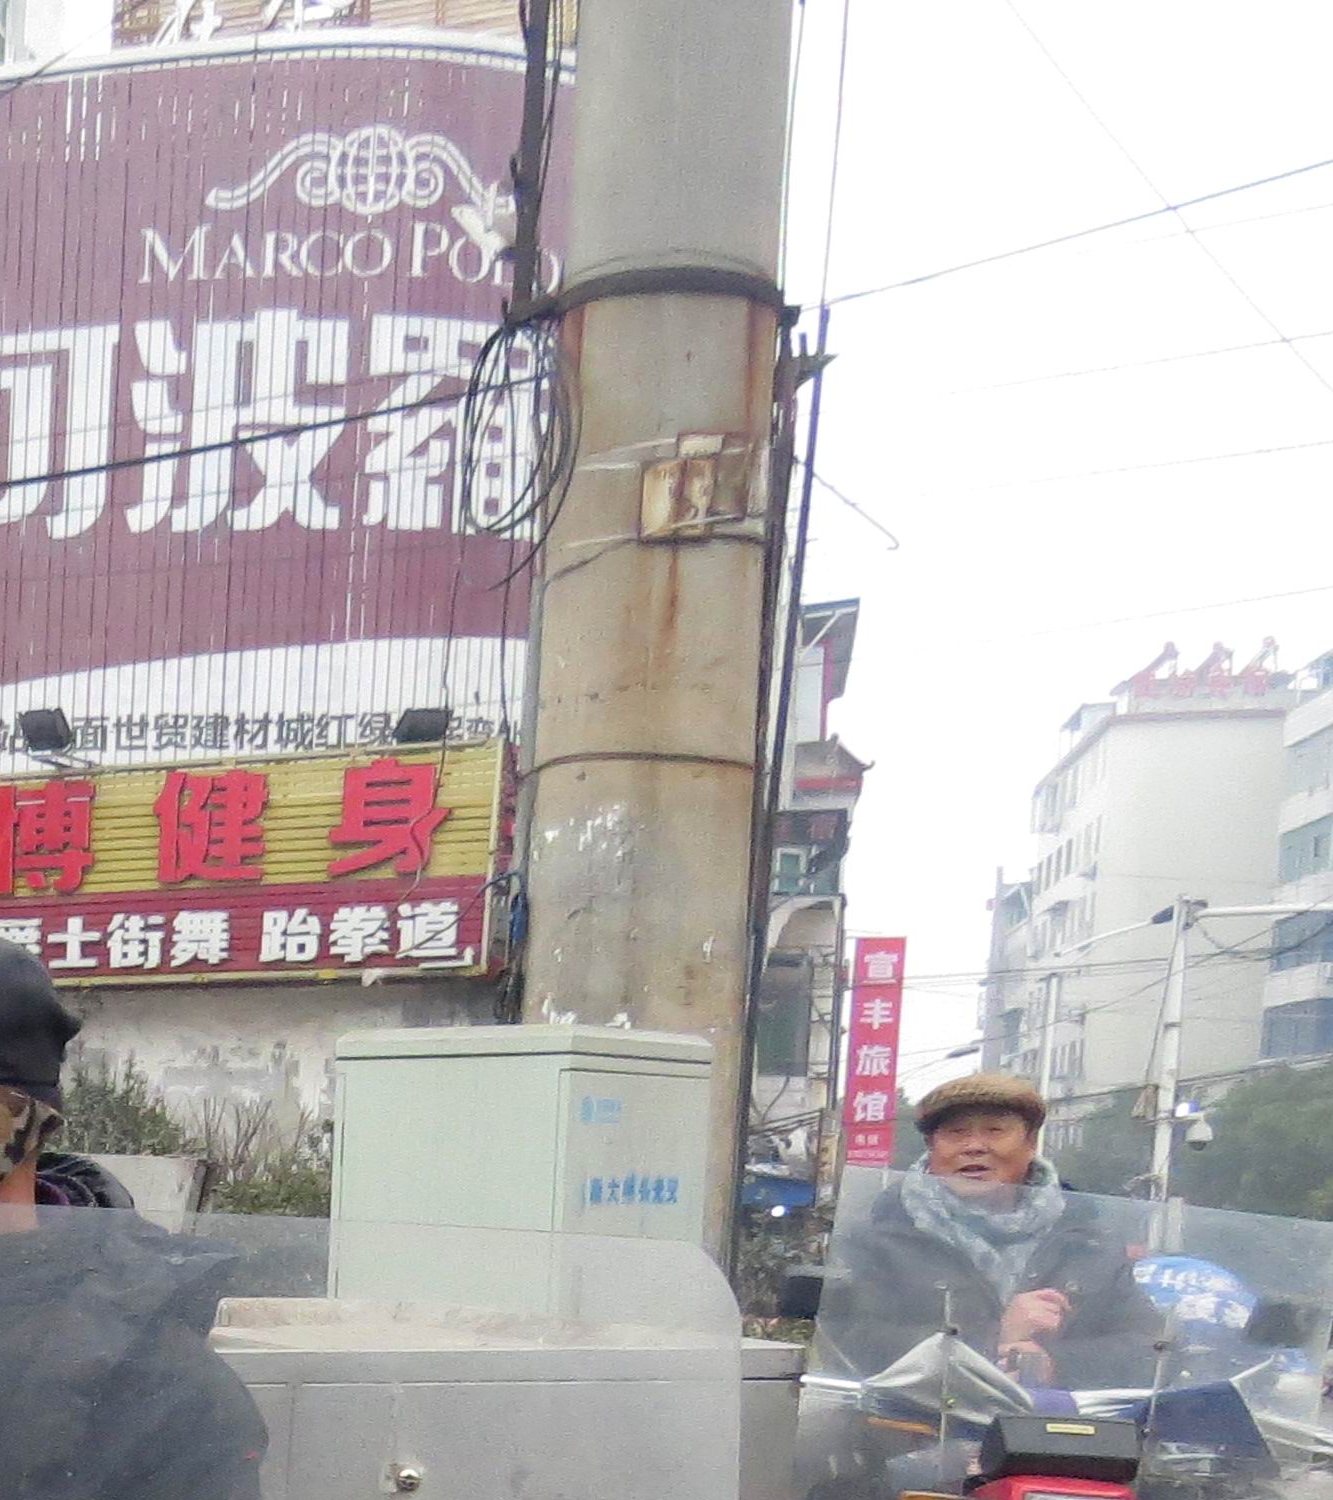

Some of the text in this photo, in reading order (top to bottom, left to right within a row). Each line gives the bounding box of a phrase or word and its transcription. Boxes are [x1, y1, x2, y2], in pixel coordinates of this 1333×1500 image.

[136, 221, 393, 284] MARCO
[258, 902, 474, 970] 跆拳道
